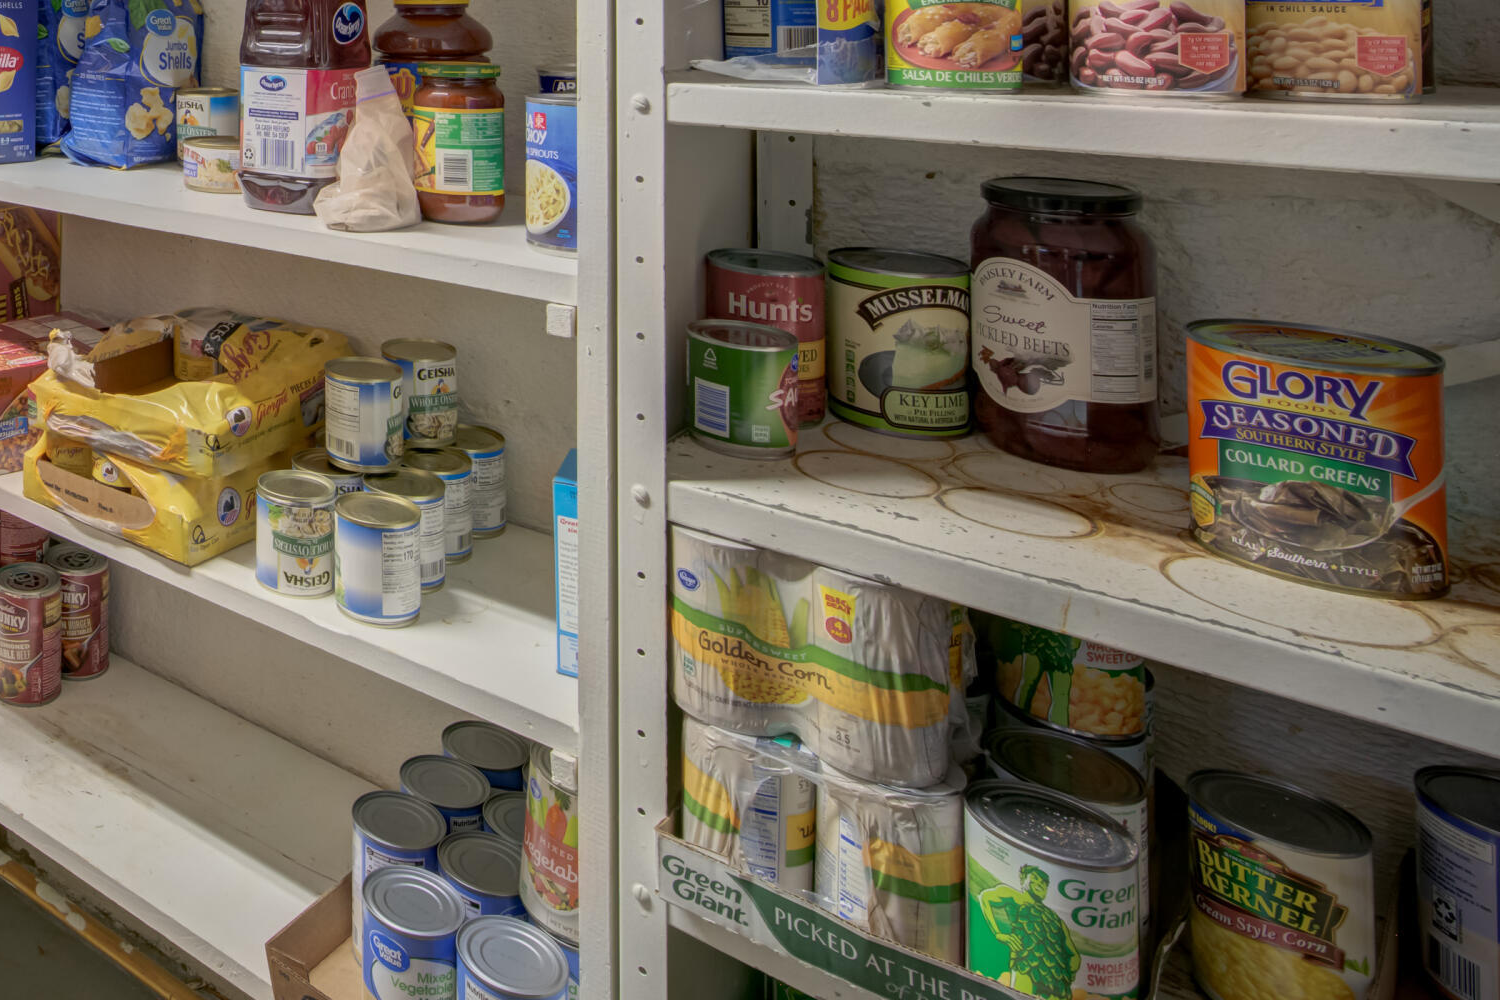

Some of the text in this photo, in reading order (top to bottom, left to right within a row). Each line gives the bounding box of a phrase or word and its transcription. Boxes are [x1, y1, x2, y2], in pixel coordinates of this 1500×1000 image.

[150, 16, 172, 25] Great
[1278, 5, 1347, 13] CHILI SAUCE
[165, 41, 188, 52] Jumbo
[158, 52, 192, 71] Shells
[902, 69, 995, 83] SALSA DE CHILES
[983, 305, 1046, 334] Sweet
[1023, 335, 1070, 357] BEETS
[417, 367, 455, 381] GEISHA
[899, 394, 964, 409] KEY LIME
[1221, 359, 1384, 422] GLORY
[1266, 398, 1338, 416] FOODS
[1211, 404, 1400, 460] SEASONED
[1235, 426, 1367, 463] SOUTHERN STYLE
[1225, 448, 1382, 492] COLLARD GREENS
[1266, 548, 1329, 571] Southern
[1339, 564, 1379, 577] STYLE
[283, 570, 331, 587] GEISHA
[699, 630, 831, 690] Golden Corn
[662, 853, 743, 904] Green
[1197, 838, 1318, 913] BUTTER
[1057, 879, 1135, 904] Green
[1200, 862, 1318, 934] KERNEL
[1236, 916, 1327, 953] Style Corn
[373, 935, 403, 960] Great
[775, 907, 950, 1000] PICKED AT THE
[417, 969, 453, 983] Mixed
[1087, 962, 1123, 975] WHOLE
[1087, 974, 1125, 987] SWEET
